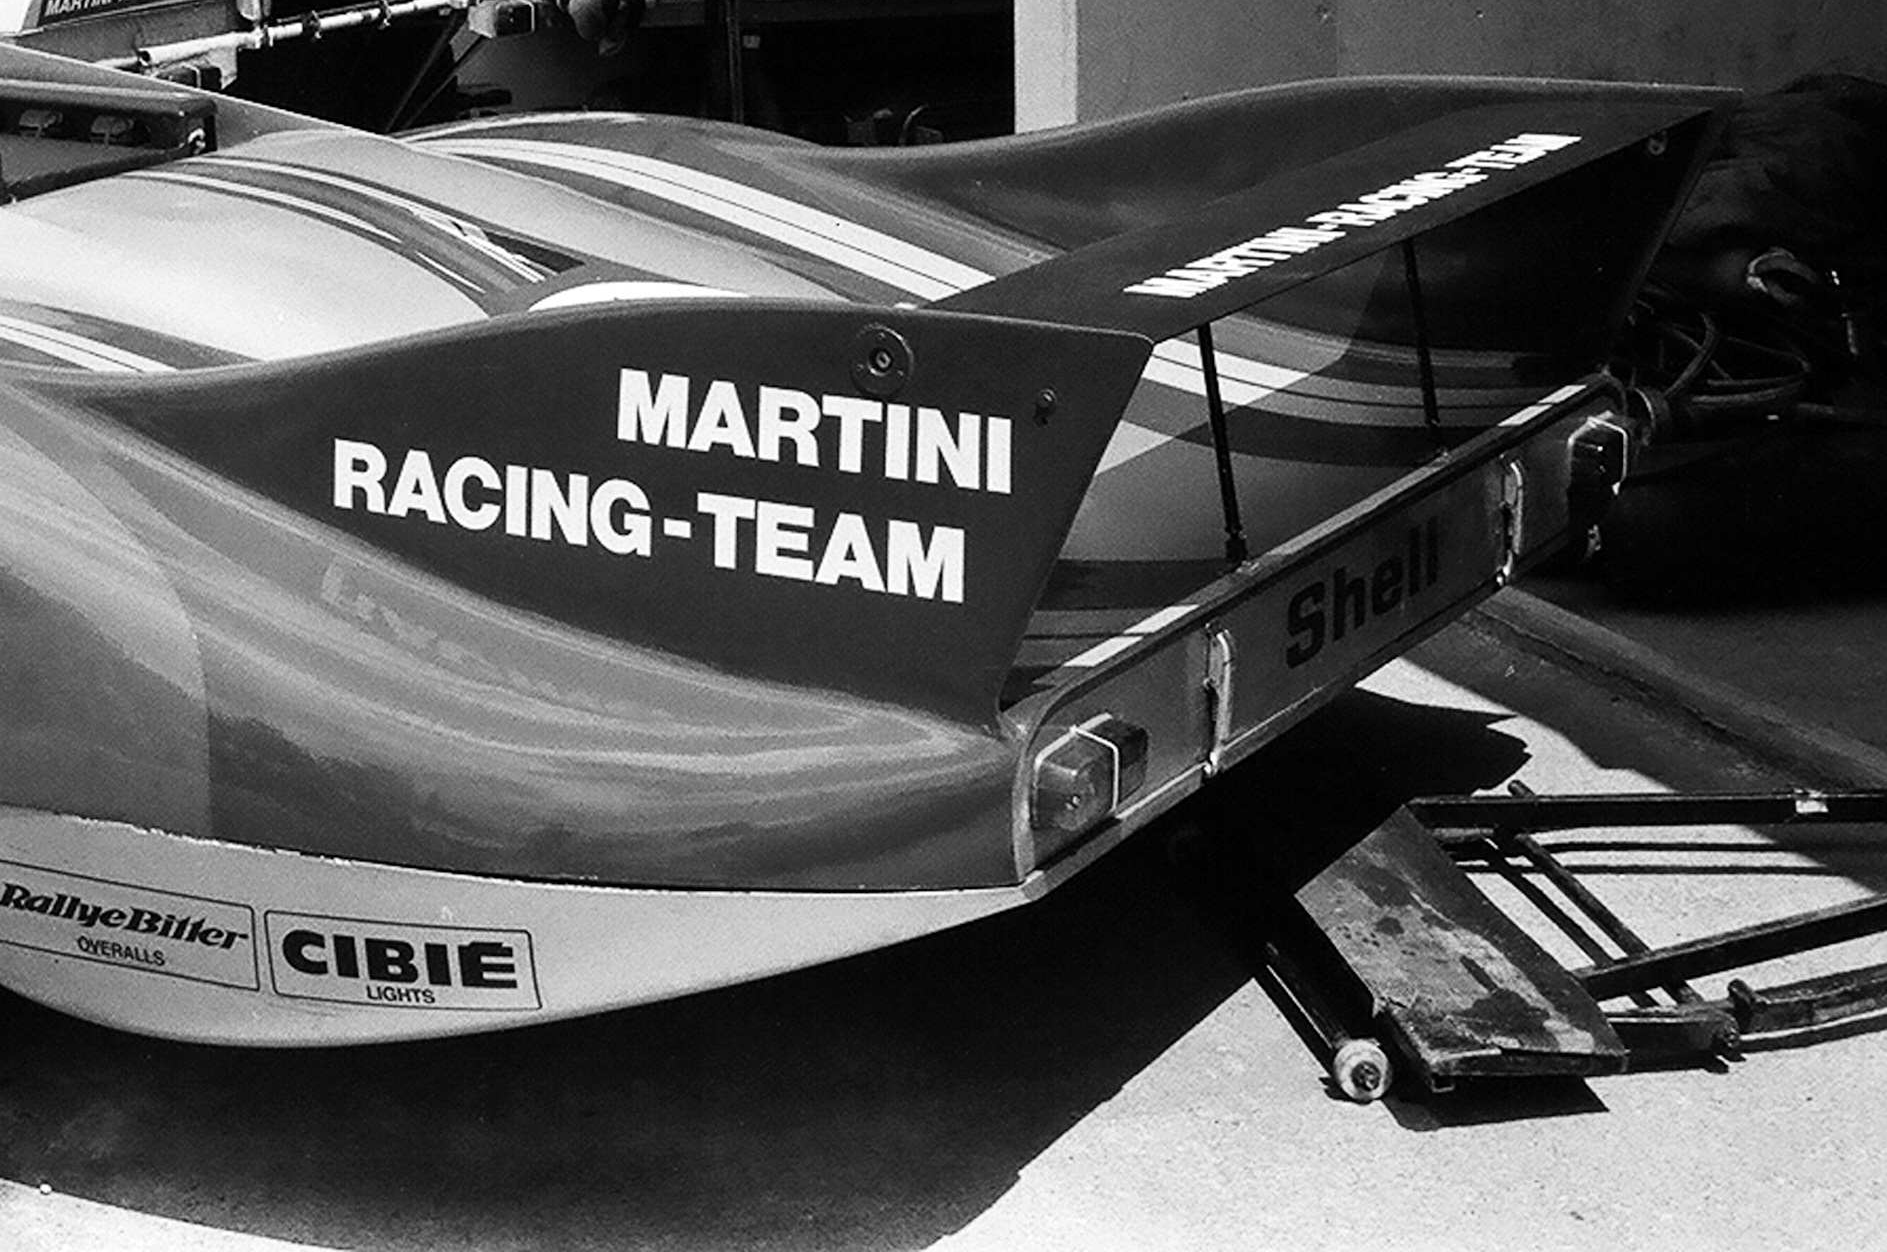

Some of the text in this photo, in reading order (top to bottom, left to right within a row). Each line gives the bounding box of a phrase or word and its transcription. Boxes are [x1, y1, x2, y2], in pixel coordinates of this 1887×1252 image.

[1123, 133, 1582, 298] MARTINI-RACING-TEAM
[616, 367, 1013, 495] MARTINI
[332, 438, 965, 604] RACING-TEAM
[1285, 516, 1440, 670] Shell
[76, 935, 166, 967] OVERALLS
[366, 984, 437, 1004] LIGHTS
